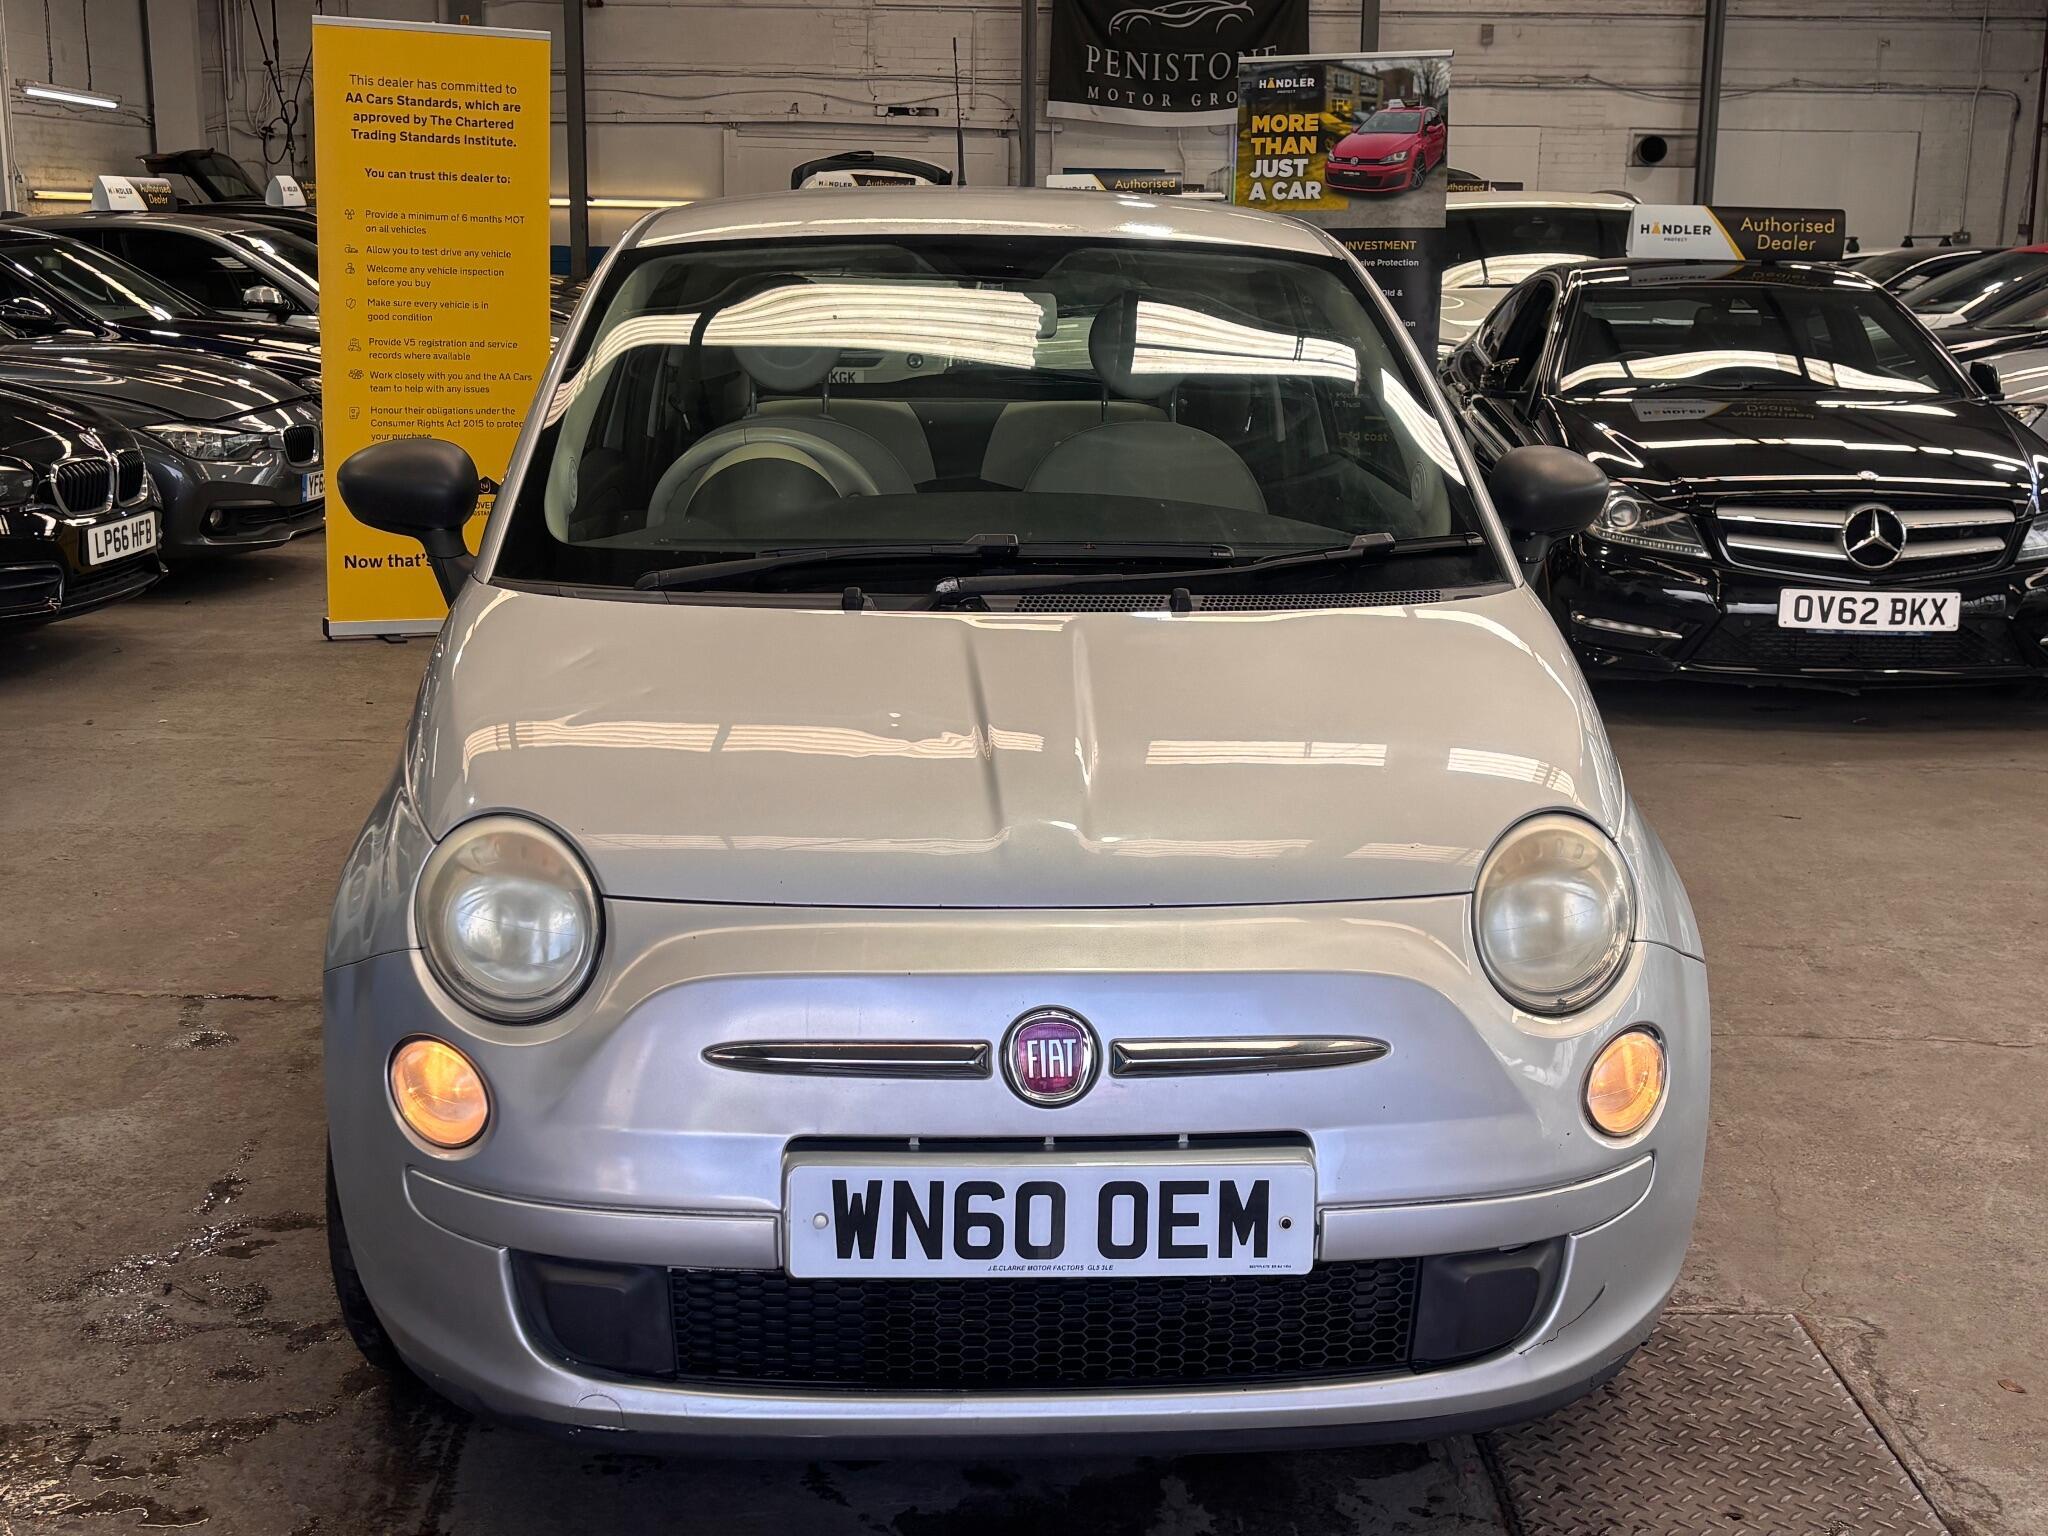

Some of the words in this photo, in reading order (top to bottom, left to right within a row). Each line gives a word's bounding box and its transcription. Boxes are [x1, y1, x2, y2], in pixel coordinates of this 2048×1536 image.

[1085, 44, 1277, 82] PENISTO
[350, 74, 374, 87] This
[377, 76, 414, 89] dealer
[417, 78, 437, 90] has
[440, 80, 502, 94] committed
[505, 83, 517, 95] to
[345, 92, 363, 103] AA
[366, 94, 393, 105] Cars
[396, 95, 462, 110] Standards,
[465, 99, 500, 111] which
[503, 103, 521, 112] are
[1088, 86, 1171, 107] MOTOR
[1191, 91, 1238, 107] GRO
[353, 113, 410, 125] approved
[413, 114, 427, 126] by
[429, 115, 452, 126] The
[455, 116, 514, 130] Chartered
[1252, 113, 1319, 133] MORE
[351, 129, 396, 143] Trading
[399, 131, 461, 145] Standards
[464, 134, 517, 147] Institute.
[1251, 136, 1317, 155] THAN
[1250, 158, 1309, 178] JUST
[365, 168, 384, 179] You
[387, 170, 406, 179] can
[409, 170, 435, 181] trust
[437, 171, 457, 182] this
[460, 172, 493, 184] dealer
[496, 174, 511, 184] to:
[1114, 177, 1176, 190] Authorised
[1248, 182, 1266, 200] A
[1272, 181, 1321, 200] CAR
[1447, 183, 1484, 191] thorised
[365, 210, 399, 220] Provide
[408, 212, 449, 222] minimum
[450, 212, 459, 222] of
[461, 214, 468, 222] 6
[470, 214, 502, 224] months
[504, 215, 525, 224] MOT
[379, 225, 389, 233] all
[391, 225, 427, 235] vehicles
[1740, 216, 1835, 234] Authorised
[1757, 234, 1817, 251] Dealer
[366, 246, 390, 254] Allow
[392, 247, 408, 257] you
[410, 247, 420, 256] to
[421, 247, 438, 256] test
[440, 248, 462, 257] drive
[464, 250, 479, 260] any
[481, 249, 512, 258] vehicle
[367, 264, 408, 274] Welcome
[409, 267, 425, 276] any
[427, 266, 458, 275] vehicle
[459, 267, 504, 278] inspection
[367, 278, 395, 287] before
[397, 279, 413, 288] you
[415, 279, 431, 289] buy
[367, 299, 391, 307] Make
[393, 300, 412, 308] sure
[440, 301, 470, 309] vehicle
[472, 301, 479, 309] is
[367, 313, 390, 322] good
[392, 313, 433, 322] condition
[368, 338, 402, 347] Provide
[403, 338, 416, 347] V5
[418, 339, 468, 349] registration
[469, 340, 486, 348] and
[487, 341, 518, 349] service
[369, 352, 402, 360] records
[403, 352, 431, 360] where
[433, 352, 471, 361] available
[370, 371, 393, 380] Work
[394, 372, 425, 382] closely
[427, 372, 445, 380] with
[447, 373, 463, 382] you
[465, 373, 481, 381] and
[483, 373, 497, 381] the
[498, 373, 511, 381] AA
[513, 373, 533, 381] Cars
[831, 371, 856, 384] KGK
[370, 385, 392, 393] team
[393, 385, 403, 393] to
[404, 385, 424, 395] help
[426, 385, 445, 393] with
[447, 386, 461, 395] any
[463, 385, 490, 393] issues
[370, 406, 402, 415] Honour
[404, 406, 424, 415] their
[426, 406, 473, 417] obligations
[476, 407, 500, 415] under
[502, 407, 515, 415] the
[370, 419, 414, 428] Consumer
[417, 419, 445, 429] Rights
[447, 419, 461, 428] Act
[463, 419, 484, 428] 2015
[486, 420, 495, 428] to
[496, 420, 524, 429] protec
[371, 433, 390, 441] your
[309, 473, 326, 496] YF6
[95, 529, 129, 559] LP66
[132, 518, 152, 548] HFB
[344, 555, 383, 569] Now
[1793, 595, 1879, 625] OV62
[1888, 598, 1948, 626] BKX
[1027, 1038, 1077, 1079] FIAT
[831, 1179, 1066, 1261] WN60
[1097, 1179, 1269, 1261] OEM
